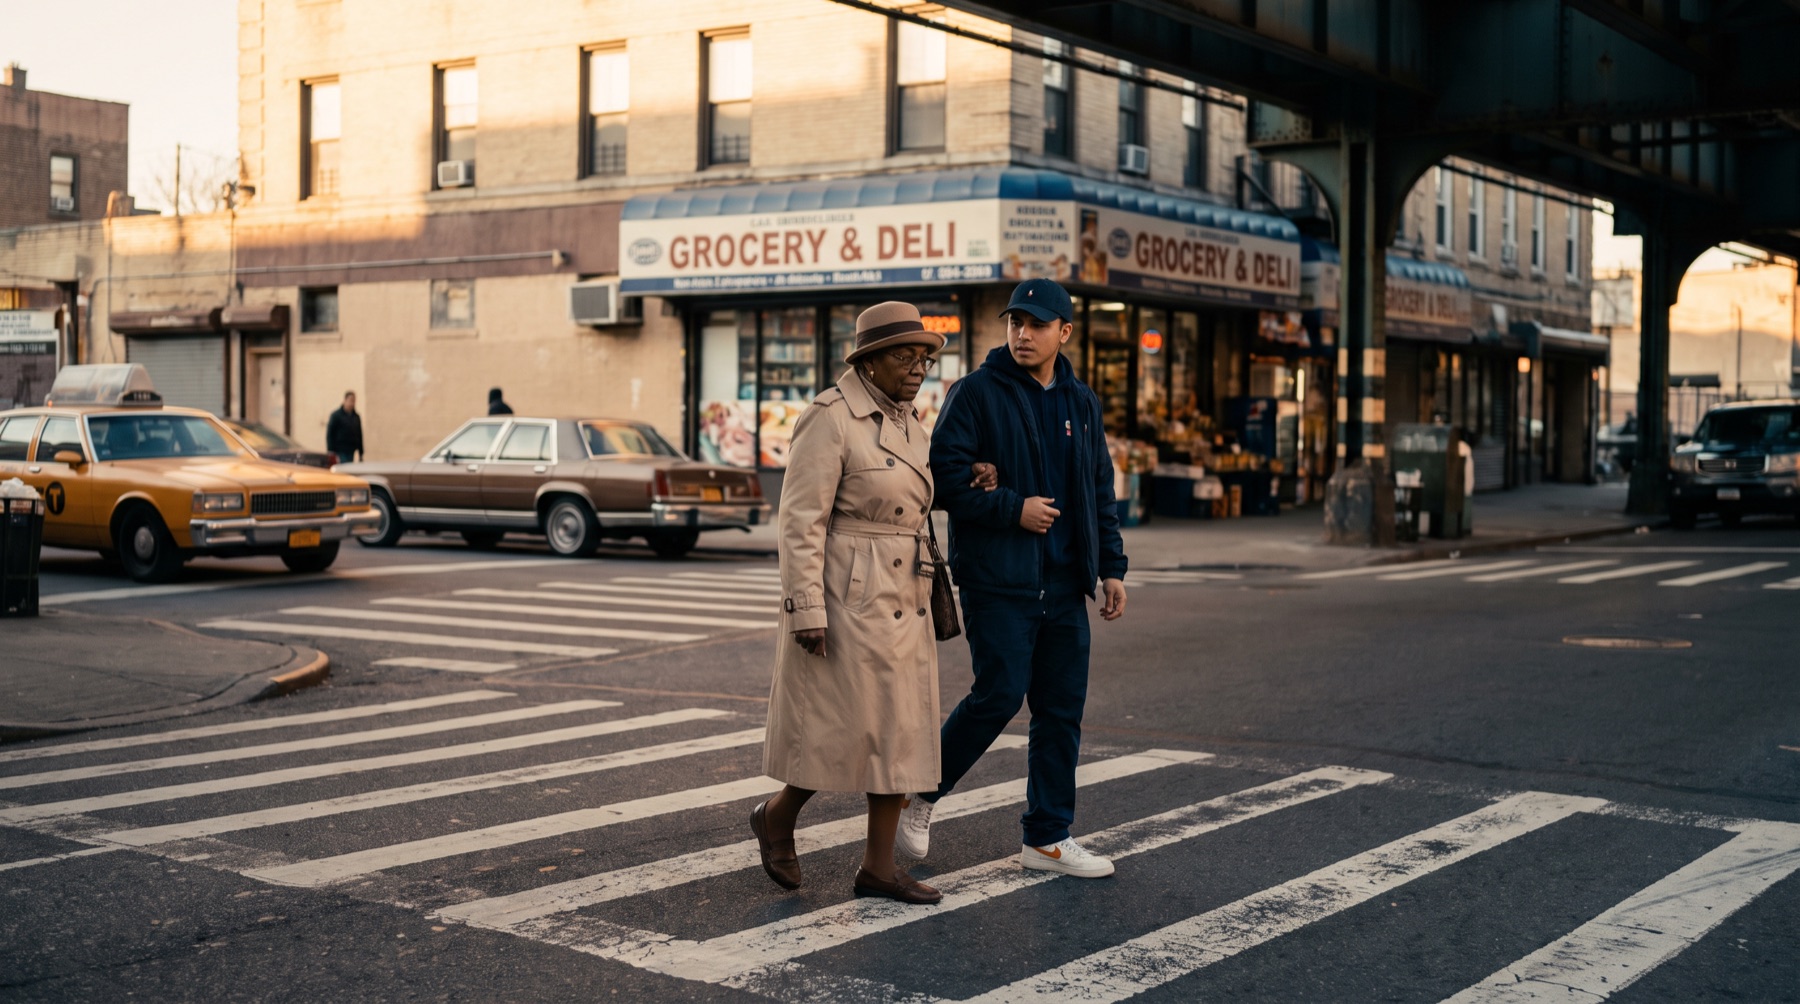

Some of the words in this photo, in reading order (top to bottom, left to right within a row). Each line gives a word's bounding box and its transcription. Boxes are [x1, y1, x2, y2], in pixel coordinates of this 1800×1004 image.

[670, 228, 828, 270] GROCERY
[839, 227, 863, 262] &
[878, 221, 956, 260] DELI
[1135, 231, 1230, 281] GROCERY
[1234, 248, 1248, 282] &
[1253, 252, 1292, 288] DELI
[49, 488, 61, 512] T
